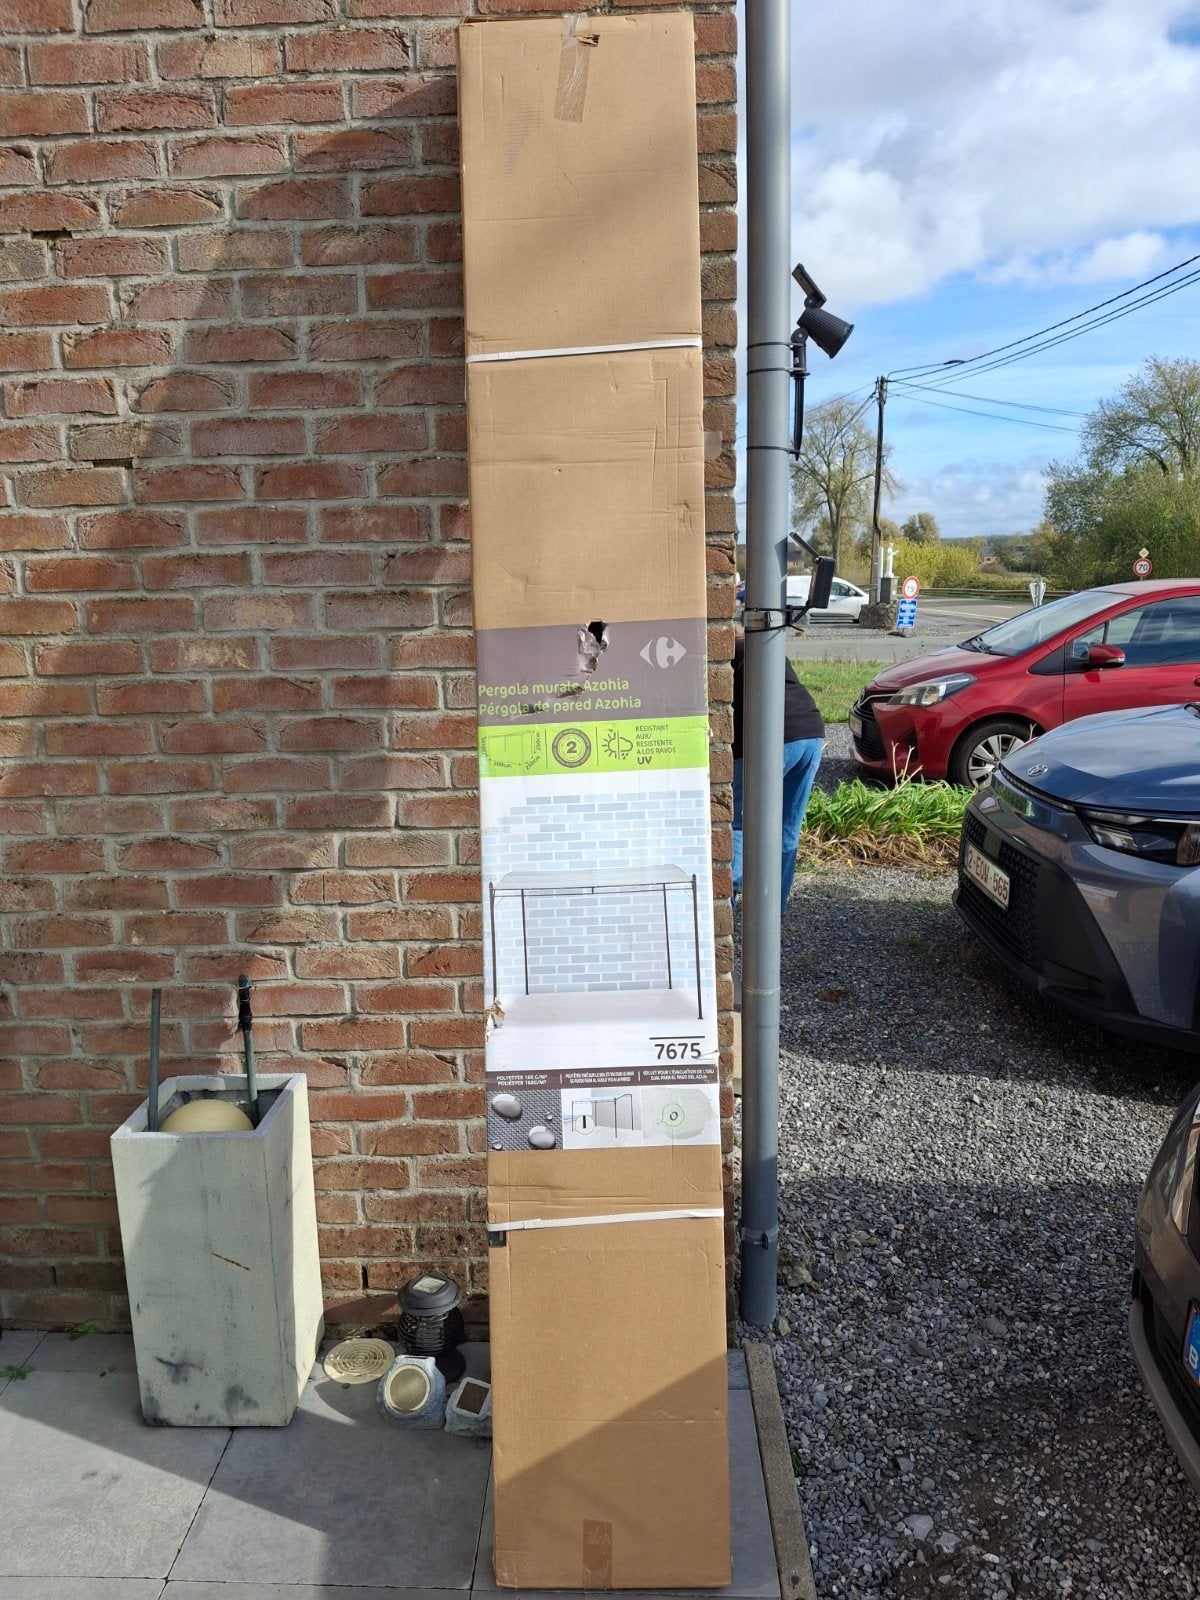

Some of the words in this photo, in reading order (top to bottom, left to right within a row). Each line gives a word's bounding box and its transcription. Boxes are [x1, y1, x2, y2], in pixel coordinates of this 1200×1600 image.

[1138, 563, 1149, 571] 70
[478, 683, 529, 698] Pergola
[584, 678, 629, 692] Azohia
[479, 701, 530, 716] Pérgola
[533, 700, 550, 712] de
[553, 698, 592, 714] pared
[595, 696, 642, 710] Azohia
[636, 732, 653, 740] AUX/
[566, 740, 578, 754] 2
[636, 739, 673, 748] RESISTENTE
[656, 746, 677, 754] RAYOS
[637, 756, 652, 765] UV
[654, 1042, 702, 1060] 7675
